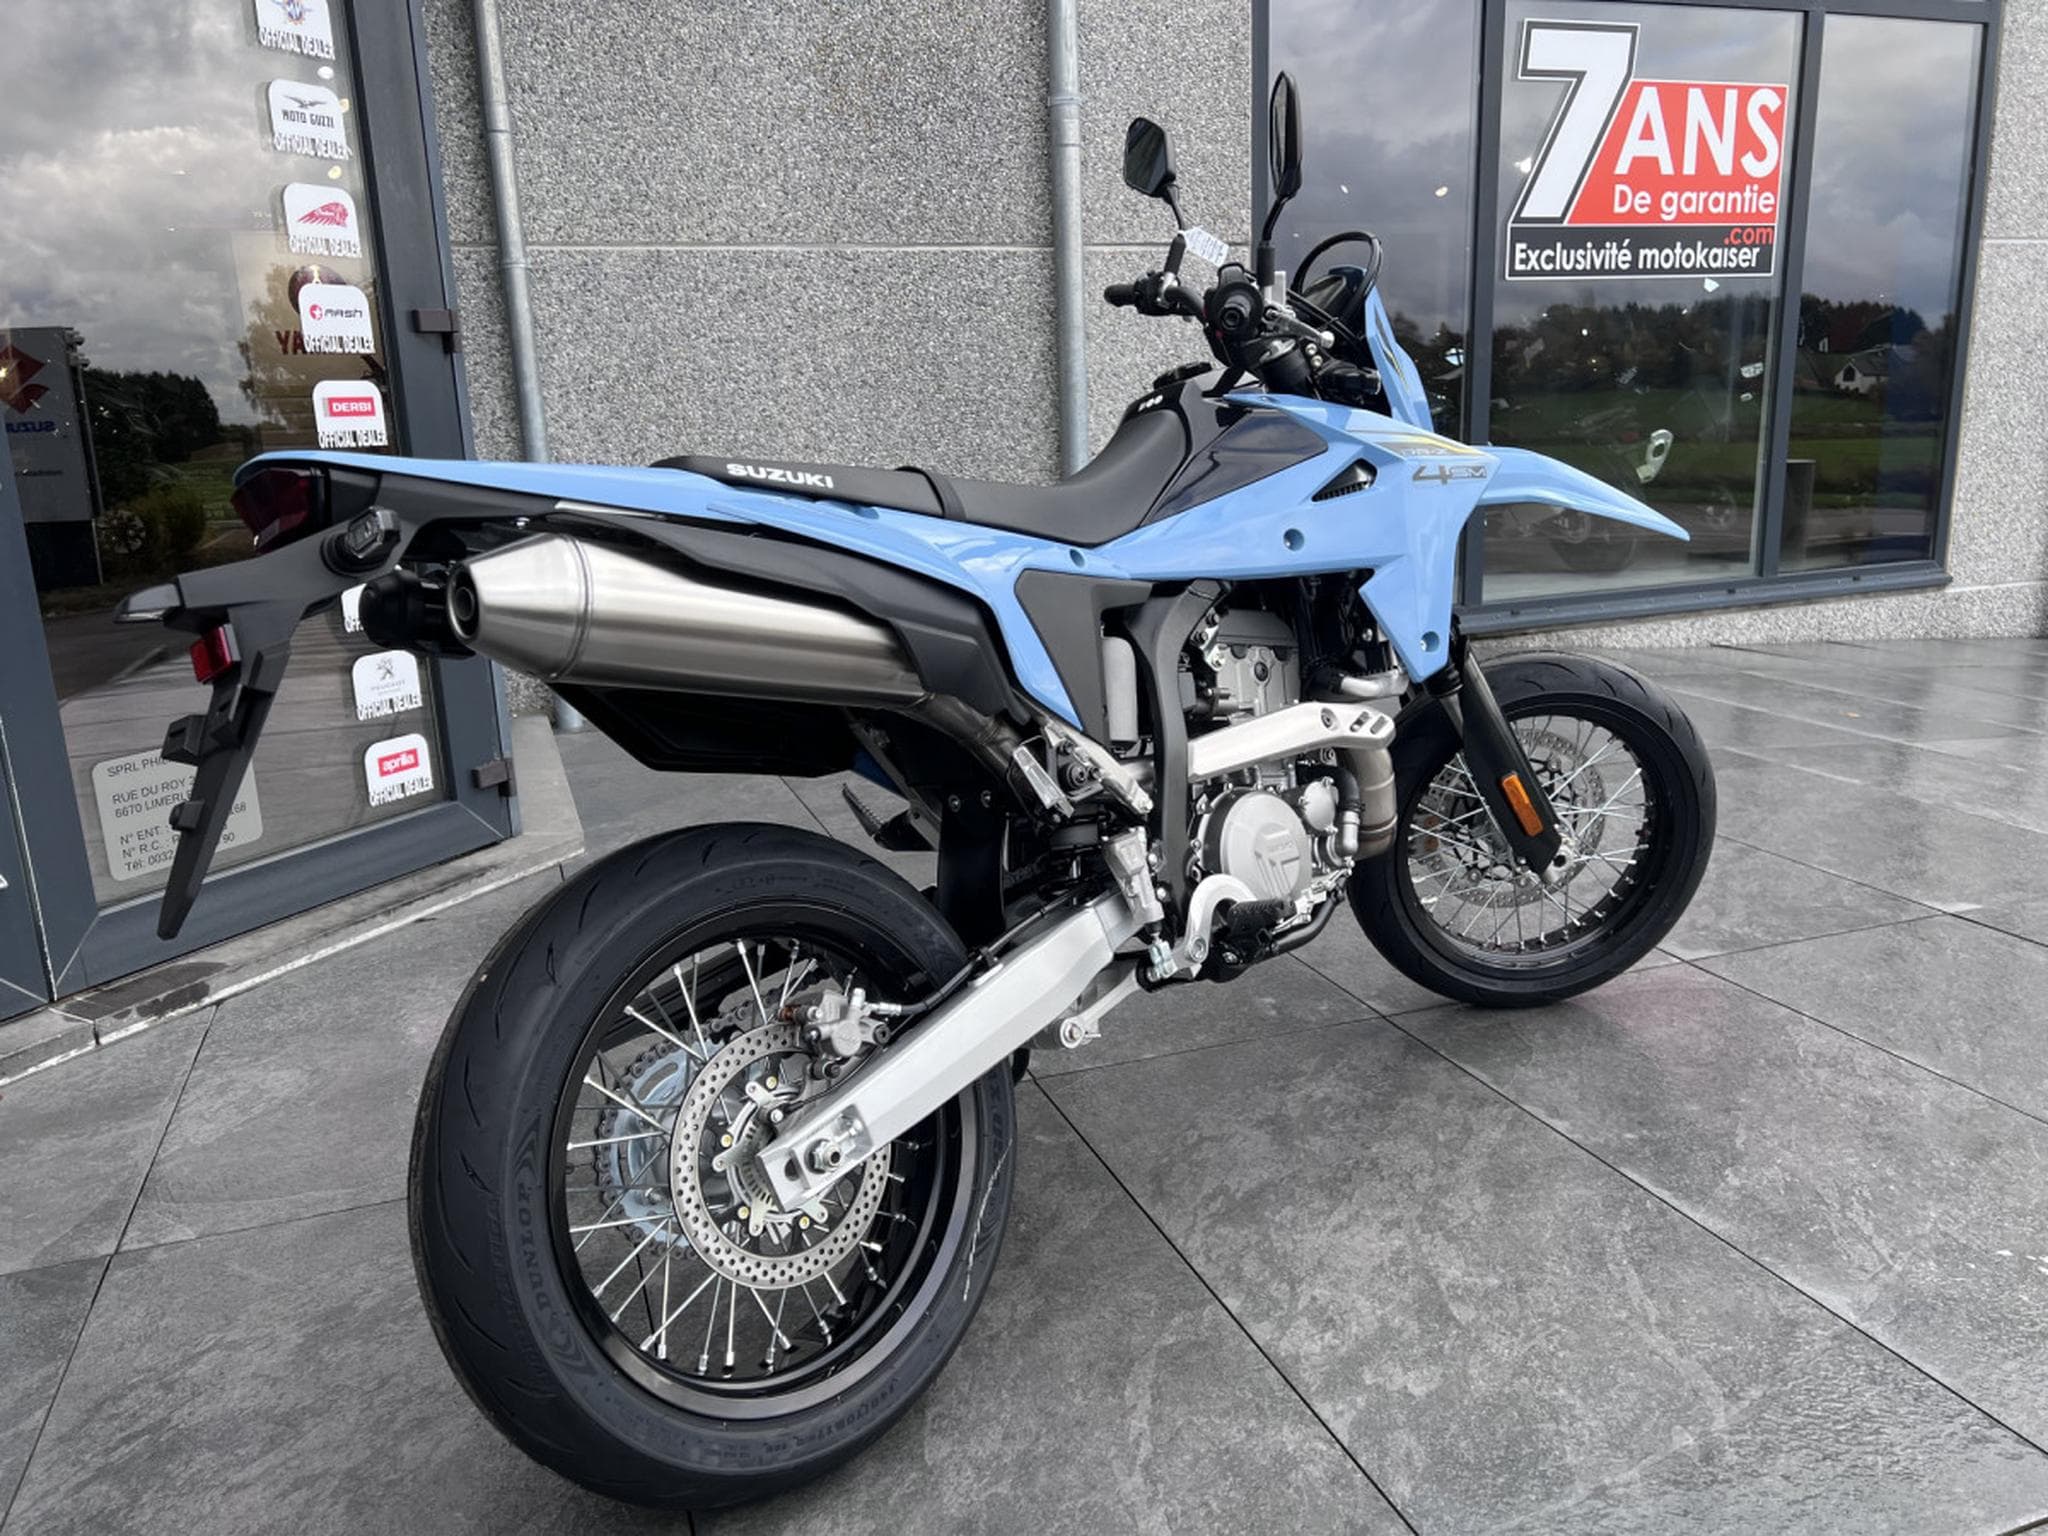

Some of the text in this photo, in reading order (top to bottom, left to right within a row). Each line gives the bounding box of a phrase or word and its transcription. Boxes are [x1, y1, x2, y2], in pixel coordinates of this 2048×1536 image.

[260, 27, 336, 60] OFFICIAL DEALER
[282, 109, 335, 129] MOTO GUZZI
[1511, 19, 1782, 224] 7 ANS
[275, 133, 352, 161] OFFICIAL DEALER
[1613, 183, 1775, 221] De garantie
[289, 235, 362, 258] OFFICIAL DEALER
[1723, 226, 1774, 245] .com
[1514, 238, 1760, 271] Exclusivité motokaiser
[305, 335, 344, 353] OFFICIAL
[344, 336, 376, 354] DEALER
[332, 401, 372, 413] DERBI
[319, 430, 388, 449] OFFICIAL DEALER
[726, 463, 834, 489] SUZUKI
[357, 693, 423, 720] OFFICIAL DEALER
[107, 762, 139, 777] SPRL
[382, 752, 415, 773] aprilia
[112, 789, 139, 804] RUE
[141, 785, 159, 798] DU
[161, 778, 186, 793] ROY
[369, 776, 434, 808] OFFICIAL DEALER
[517, 1182, 550, 1311] DUNLOP
